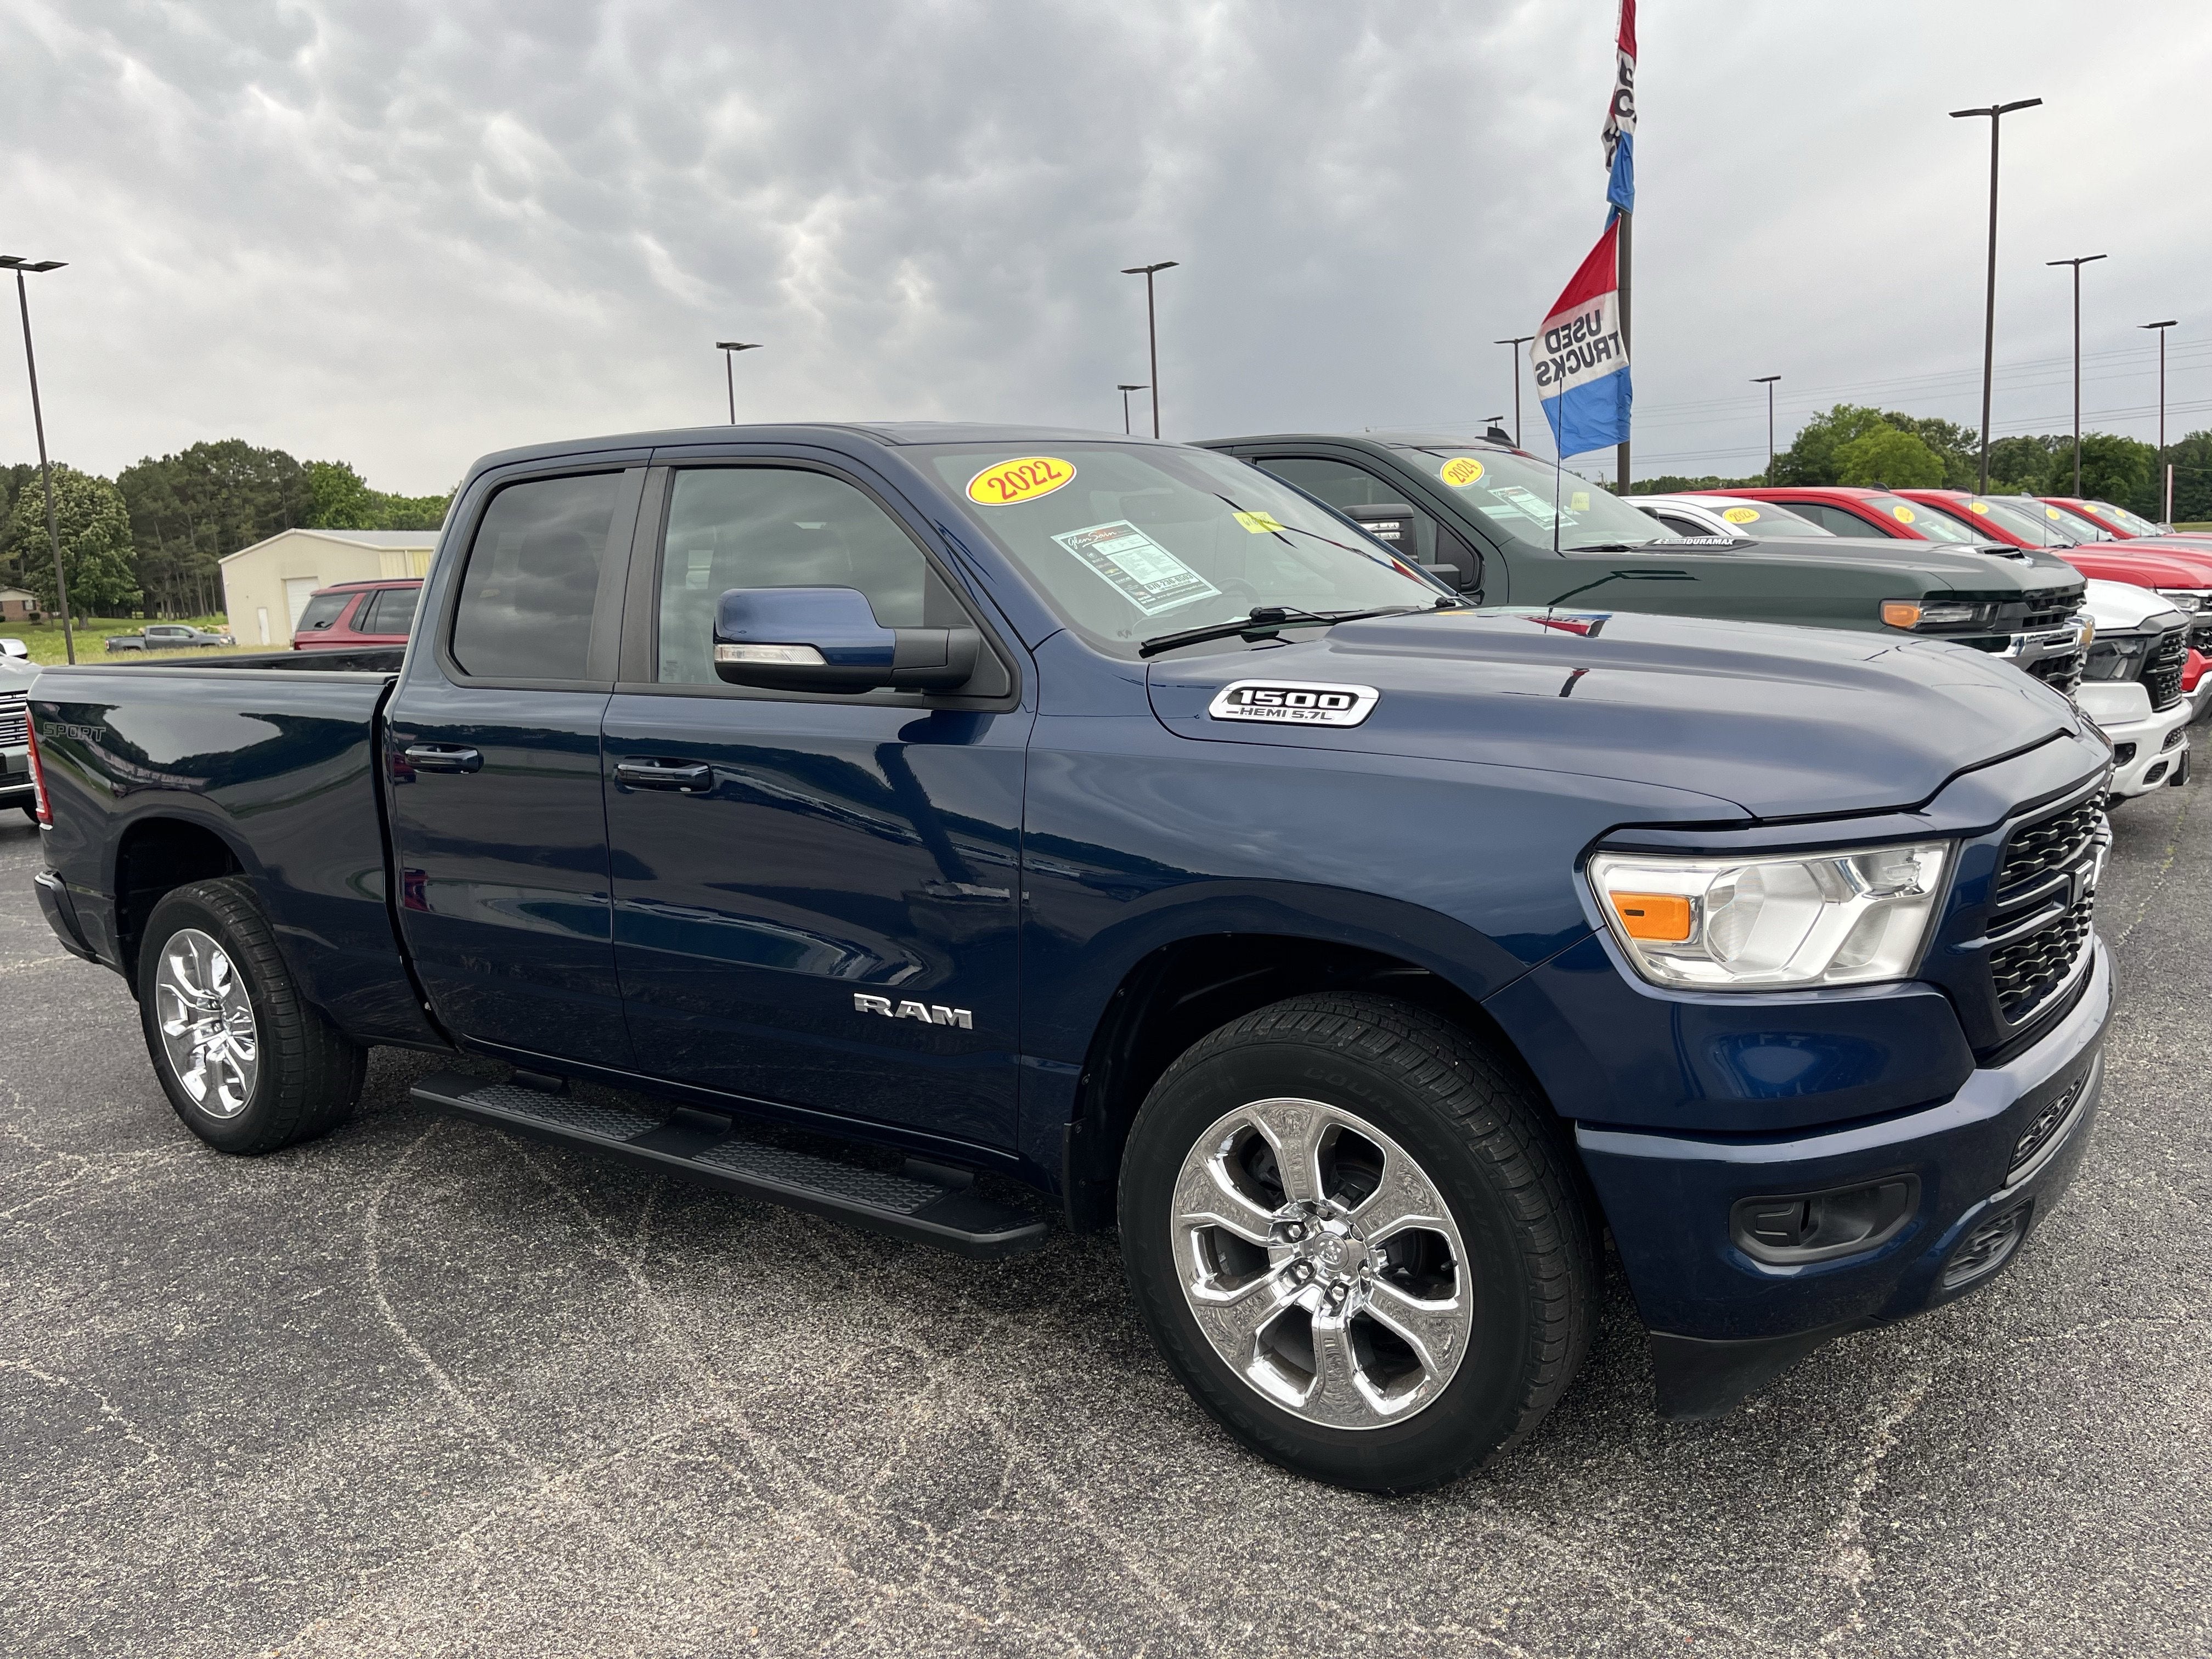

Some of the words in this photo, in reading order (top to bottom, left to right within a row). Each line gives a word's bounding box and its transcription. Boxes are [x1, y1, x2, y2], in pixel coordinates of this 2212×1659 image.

[988, 461, 1062, 500] 2022
[1448, 460, 1478, 483] 2024
[1068, 536, 1092, 549] Glen
[1088, 531, 1117, 541] Sain
[1240, 690, 1351, 710] 1500
[1239, 707, 1286, 718] HEMI
[1291, 710, 1333, 720] 5.7L
[43, 721, 106, 742] SPORT
[854, 993, 973, 1030] RAM
